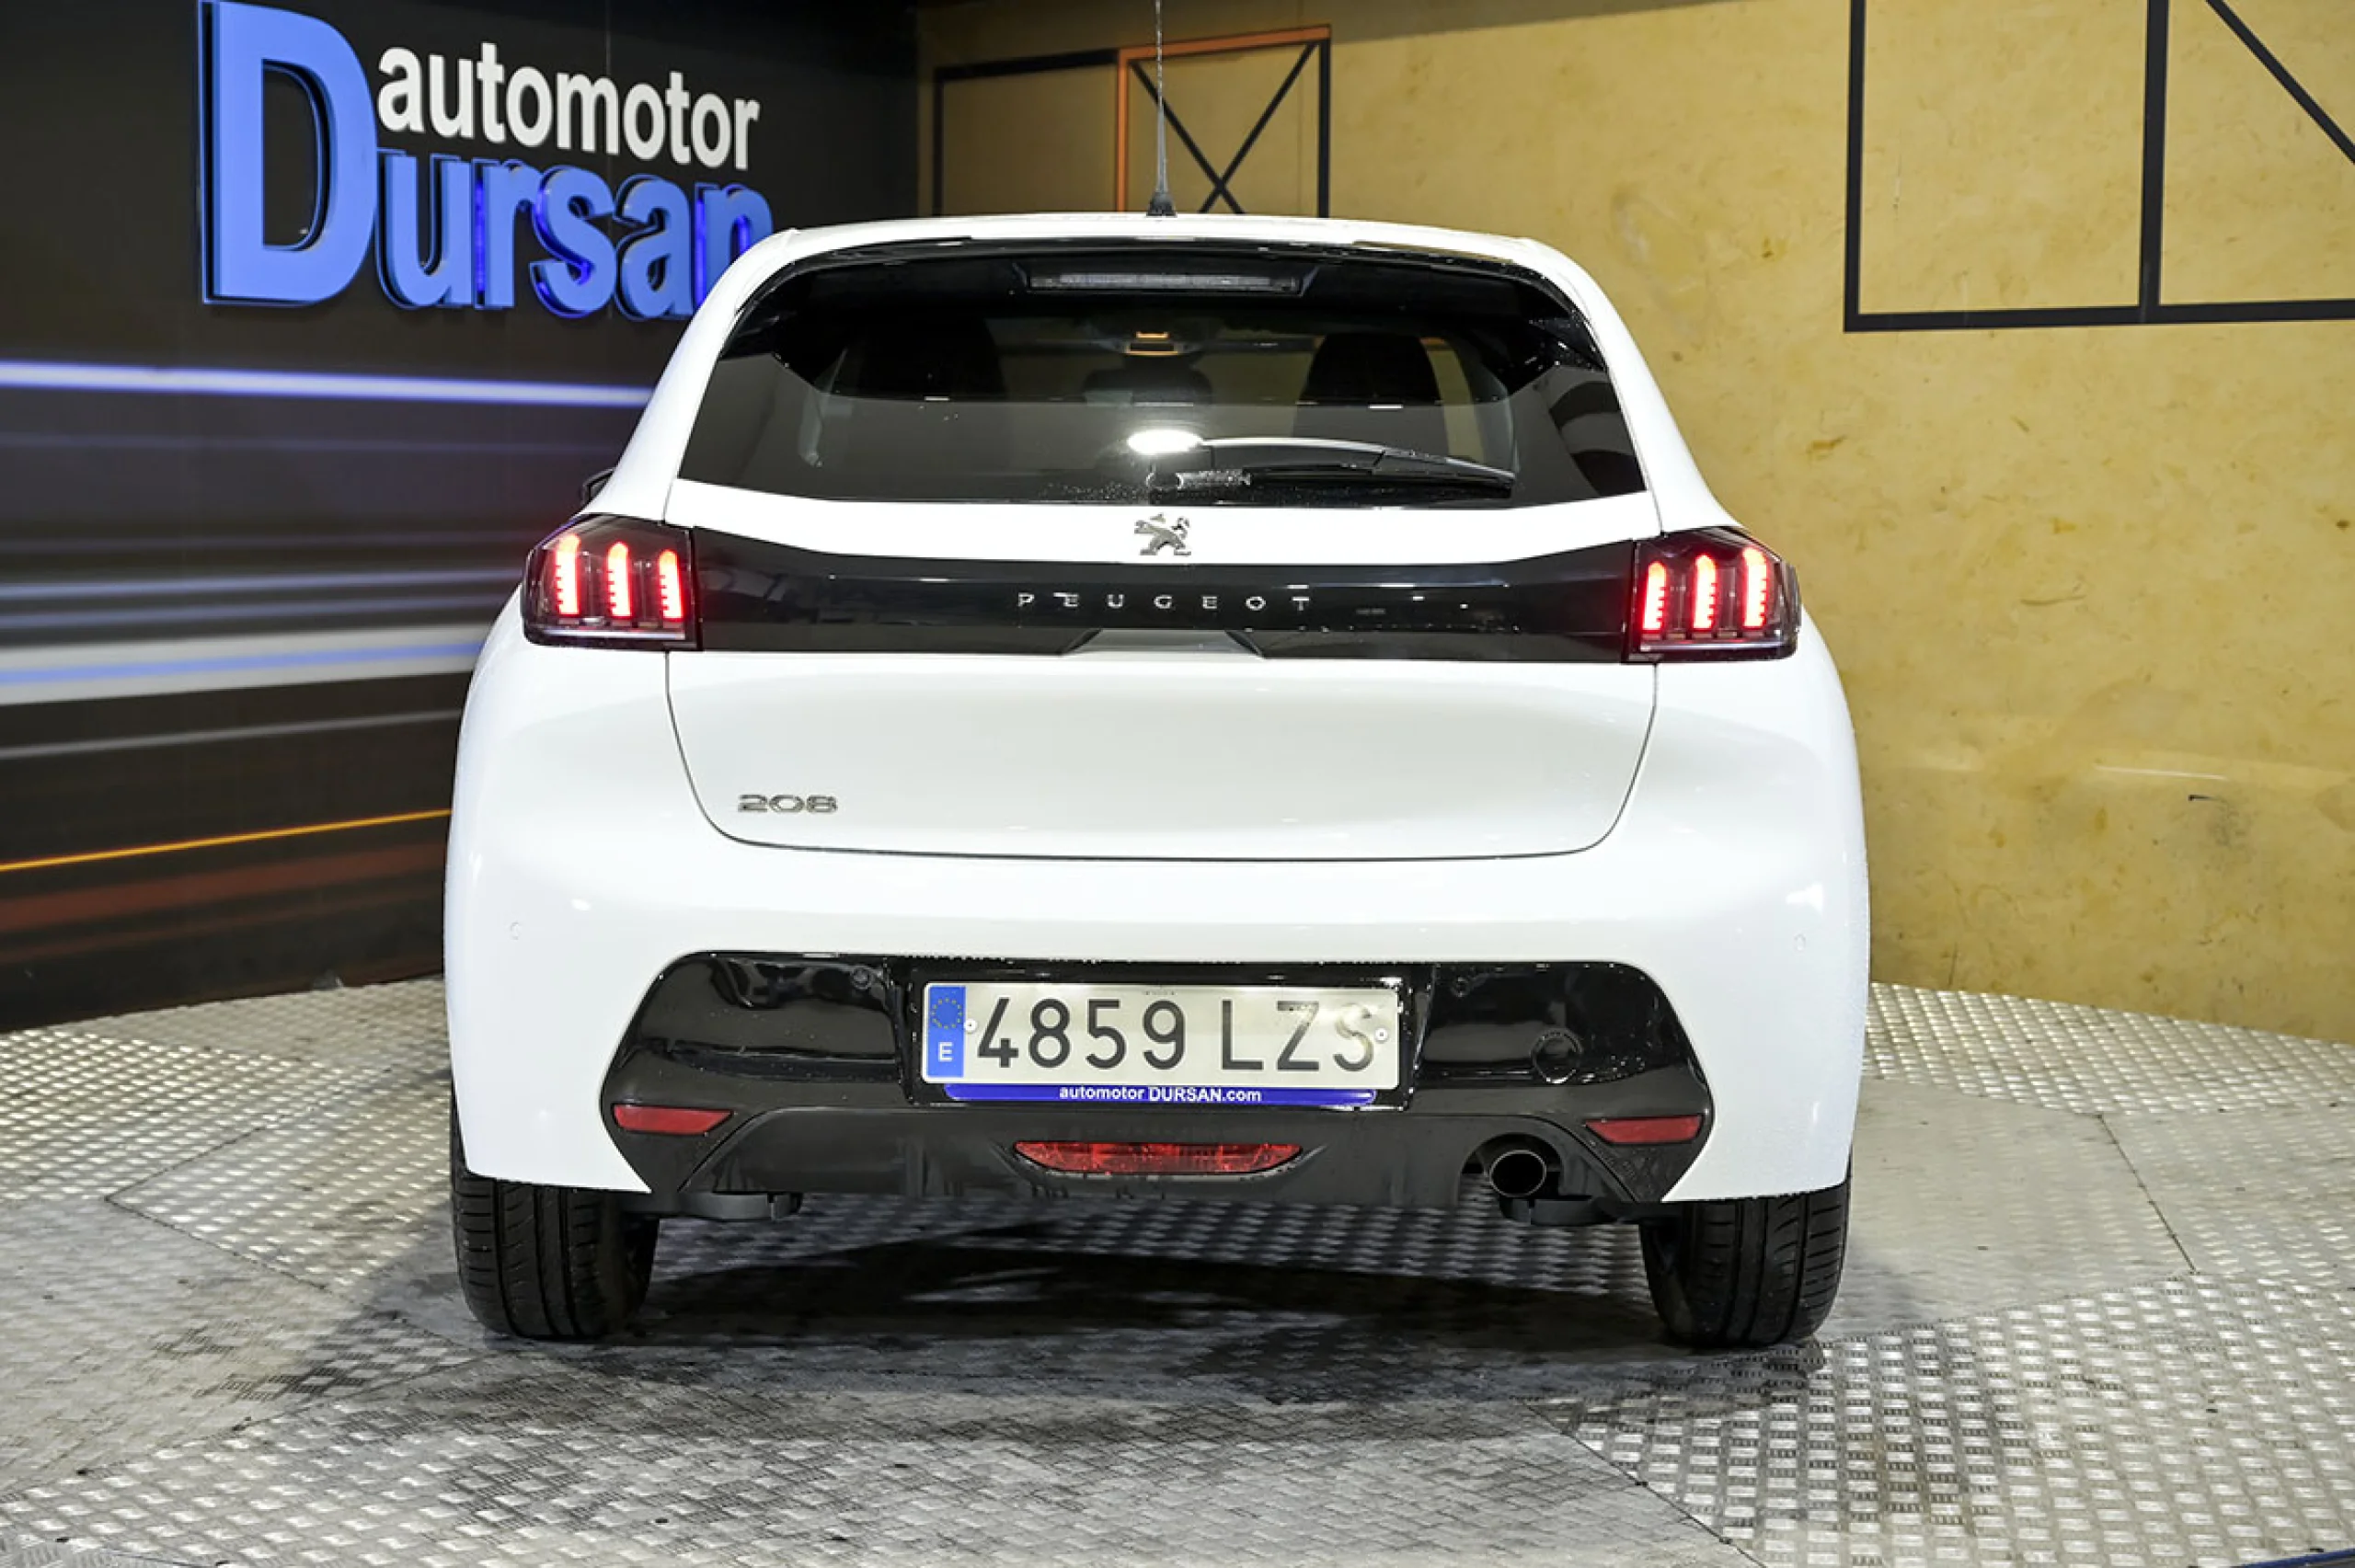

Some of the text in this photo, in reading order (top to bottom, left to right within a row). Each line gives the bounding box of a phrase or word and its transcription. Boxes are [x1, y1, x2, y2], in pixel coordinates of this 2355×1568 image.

[377, 42, 760, 171] automotor
[198, 0, 774, 321] Dursan
[1017, 592, 1310, 612] PEUGEOT
[738, 794, 838, 813] 208
[977, 998, 1375, 1072] 4859 LZS
[938, 1042, 953, 1061] E
[1059, 1084, 1262, 1103] automotor DURSAN.com
